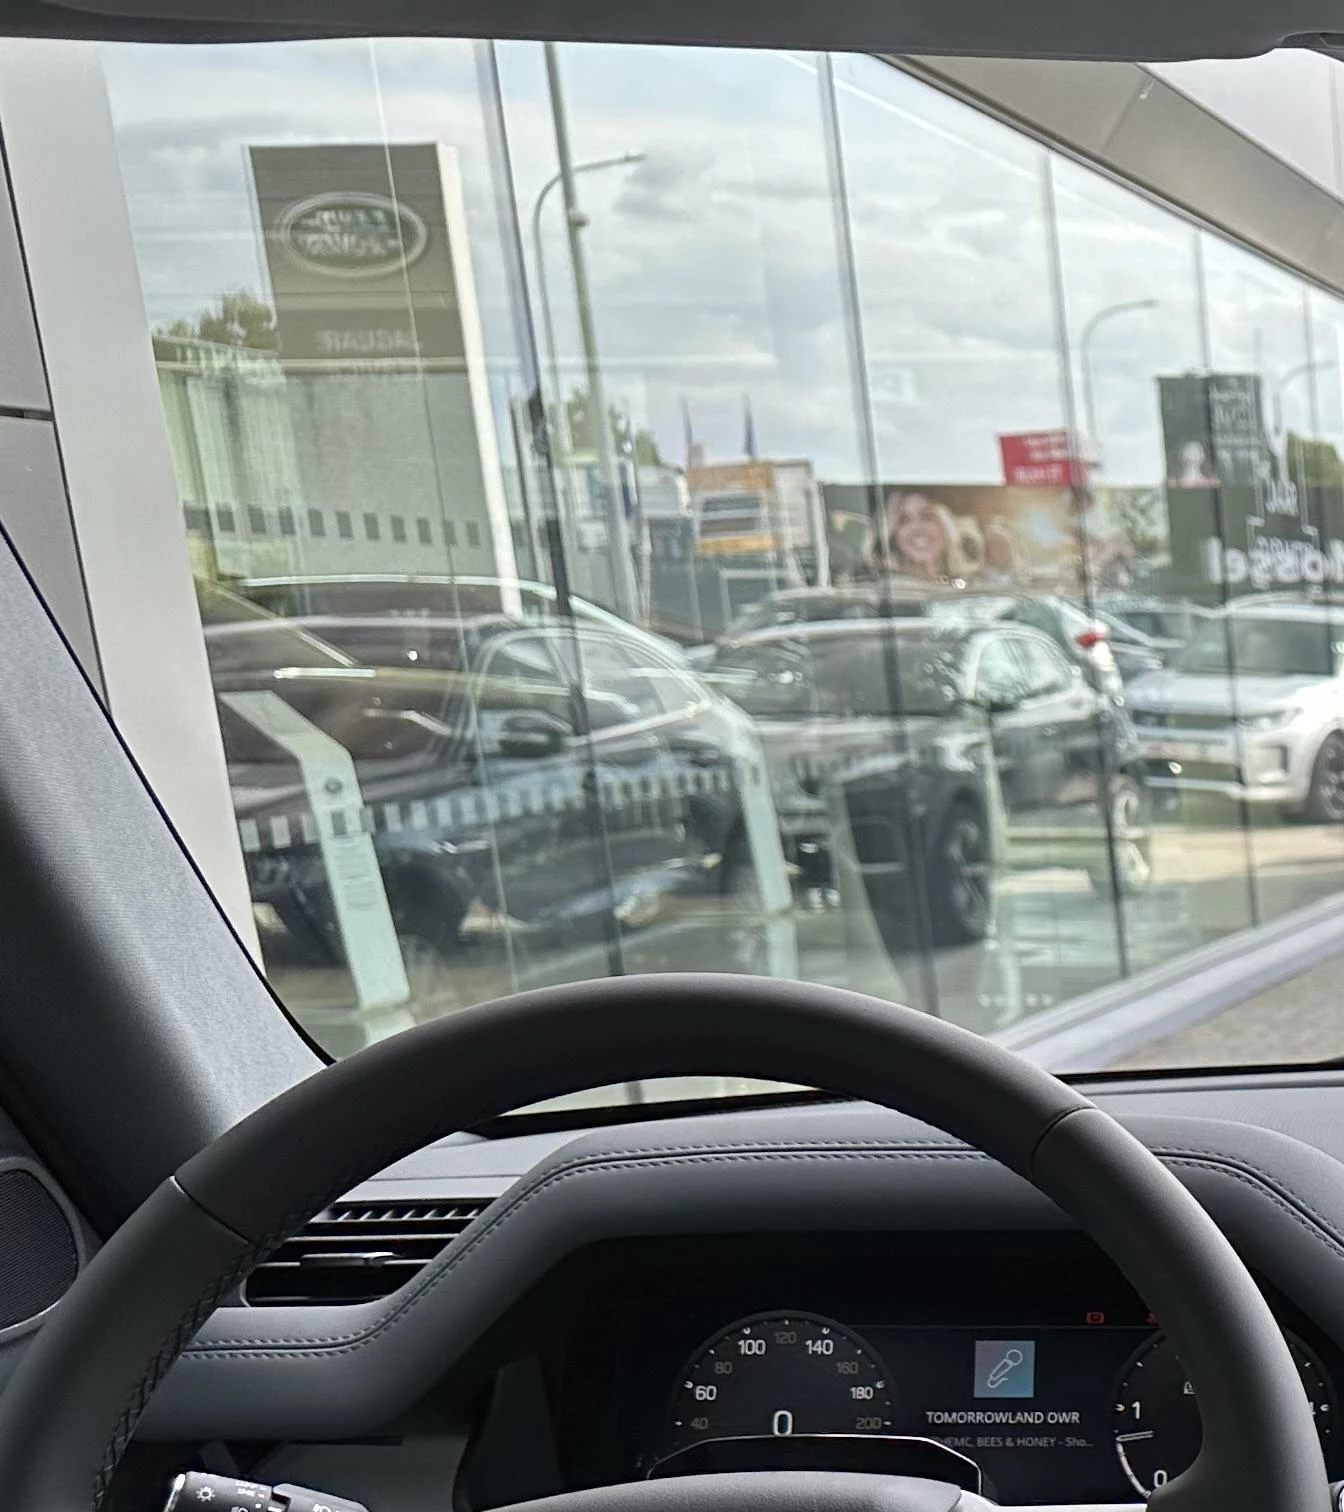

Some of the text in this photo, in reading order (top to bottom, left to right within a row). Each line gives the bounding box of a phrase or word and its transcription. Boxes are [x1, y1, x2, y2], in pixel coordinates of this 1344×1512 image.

[774, 1331, 797, 1345] 120
[738, 1339, 766, 1355] 100
[805, 1339, 834, 1355] 140
[714, 1361, 733, 1375] 80
[836, 1361, 859, 1375] 160
[695, 1385, 717, 1401] 60
[850, 1386, 874, 1400] 180
[1131, 1401, 1141, 1419] 1
[690, 1417, 709, 1430] 40
[773, 1410, 793, 1436] 0
[855, 1417, 882, 1430] 200
[925, 1411, 1080, 1424] TOMORROWLAND OWR
[977, 1437, 1002, 1447] BEES
[1006, 1437, 1015, 1447] &
[1016, 1437, 1056, 1447] HONEY
